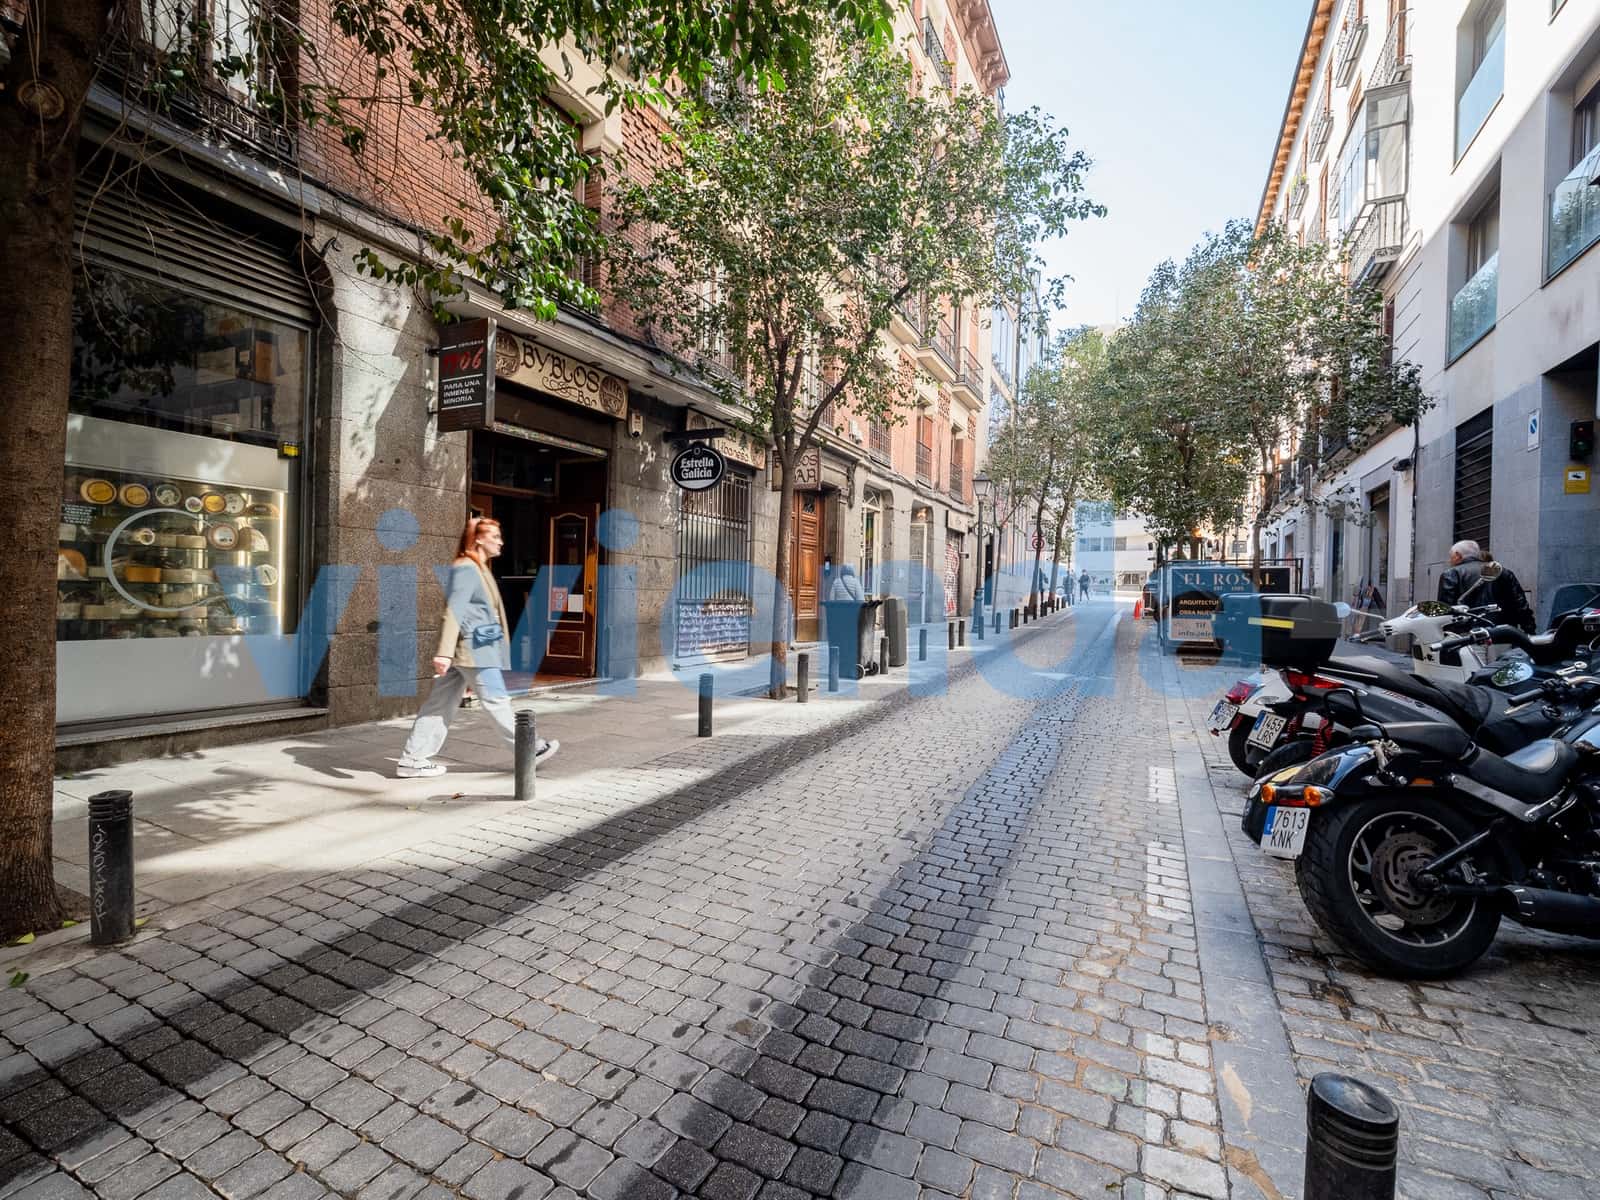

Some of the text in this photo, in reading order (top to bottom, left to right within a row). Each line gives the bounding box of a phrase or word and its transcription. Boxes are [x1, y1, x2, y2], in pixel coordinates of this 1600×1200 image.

[520, 342, 600, 393] BYBLOS
[443, 379, 481, 391] PARA UNA
[443, 388, 475, 398] INMENSA
[576, 389, 598, 407] Bar
[680, 457, 714, 469] Estrella
[681, 467, 713, 480] Galicia
[1184, 573, 1206, 585] EL
[1262, 715, 1285, 731] 1455
[1257, 729, 1274, 744] LRS
[1273, 810, 1307, 830] 7613
[1270, 831, 1295, 849] KNK
